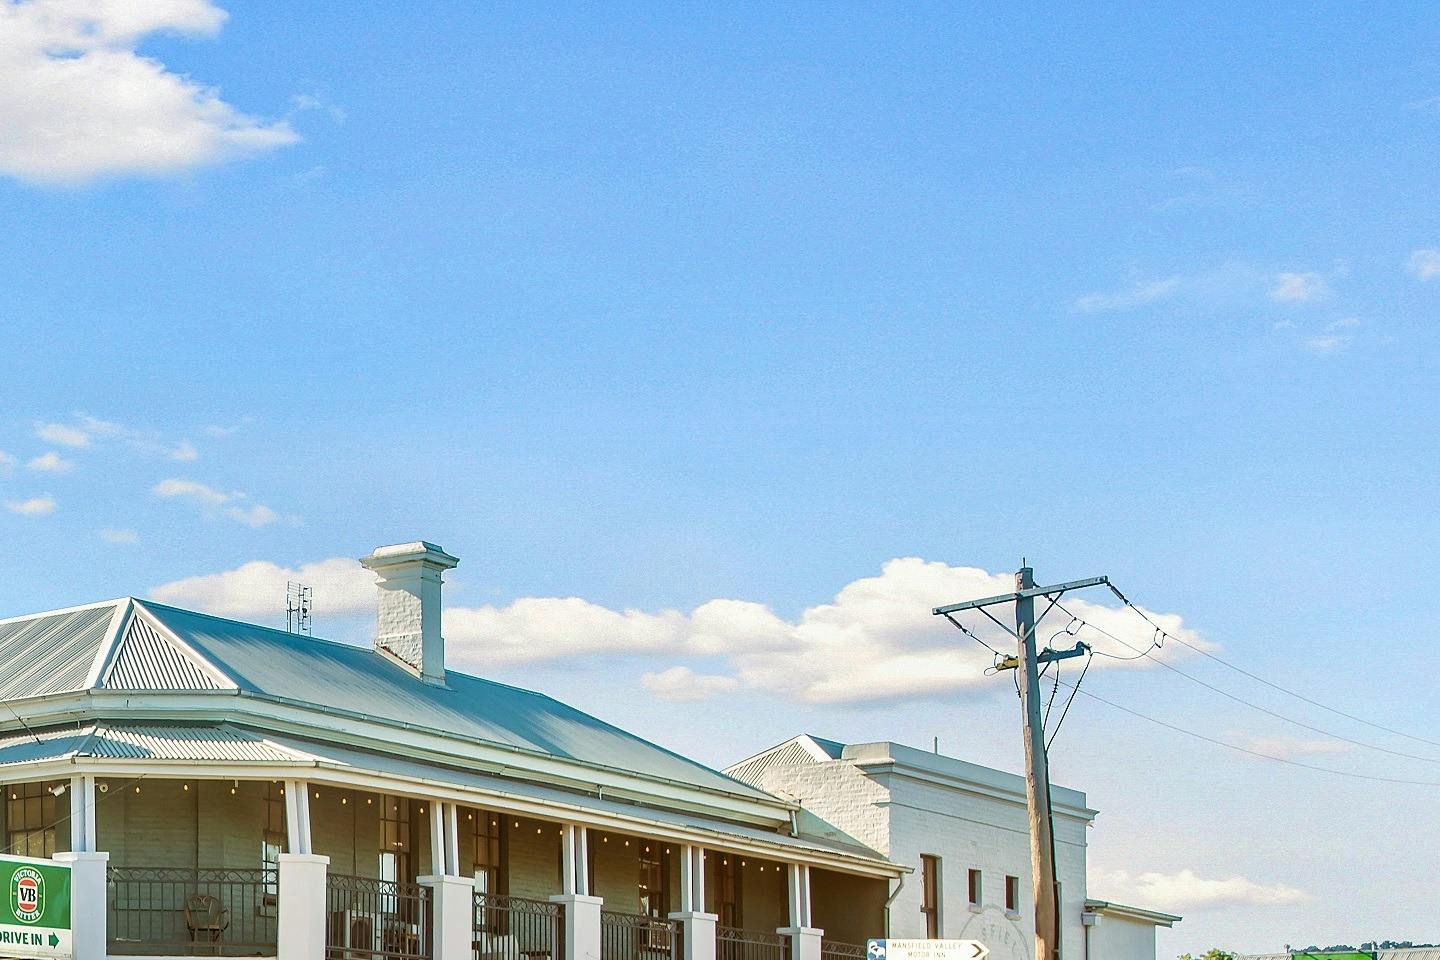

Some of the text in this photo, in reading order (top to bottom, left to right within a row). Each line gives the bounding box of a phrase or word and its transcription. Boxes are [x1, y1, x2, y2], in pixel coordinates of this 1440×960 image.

[14, 869, 41, 885] VICTORIA
[20, 887, 36, 902] VB
[16, 908, 40, 920] BITTER
[31, 933, 43, 946] IN
